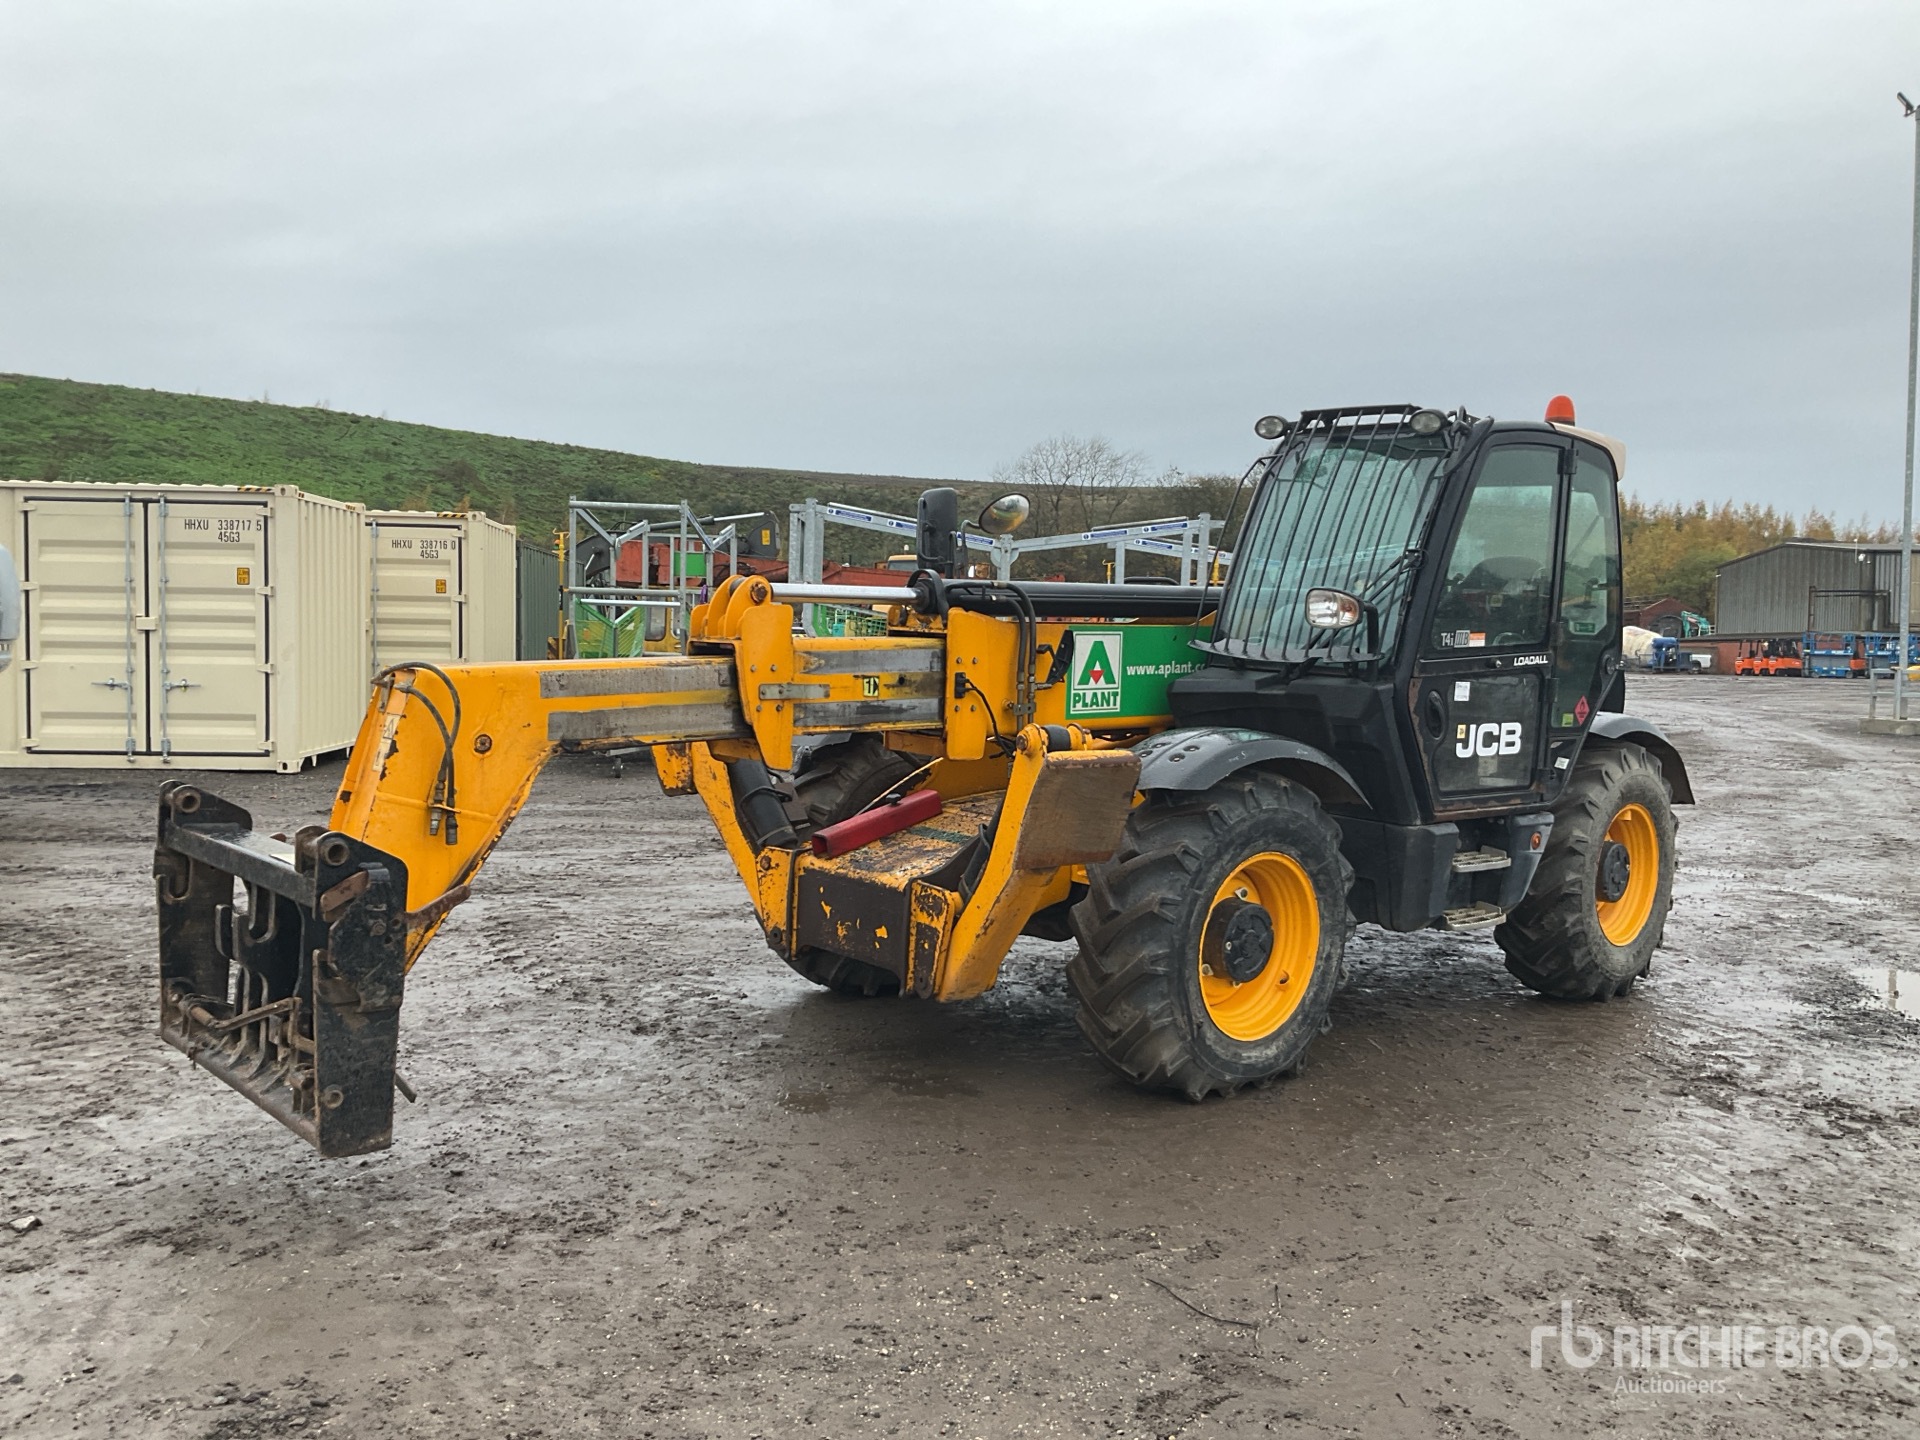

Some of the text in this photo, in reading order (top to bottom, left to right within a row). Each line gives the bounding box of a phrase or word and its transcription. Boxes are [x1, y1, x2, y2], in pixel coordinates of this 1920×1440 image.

[184, 518, 262, 532] HHXU 338717 5
[217, 531, 241, 543] 45G3
[391, 539, 413, 549] HHXU
[419, 540, 448, 550] 338716
[419, 549, 439, 559] 45G3
[1077, 640, 1117, 686] A
[1513, 655, 1549, 667] LOADALL
[1072, 691, 1119, 709] PLANT
[1455, 722, 1522, 758] JCB
